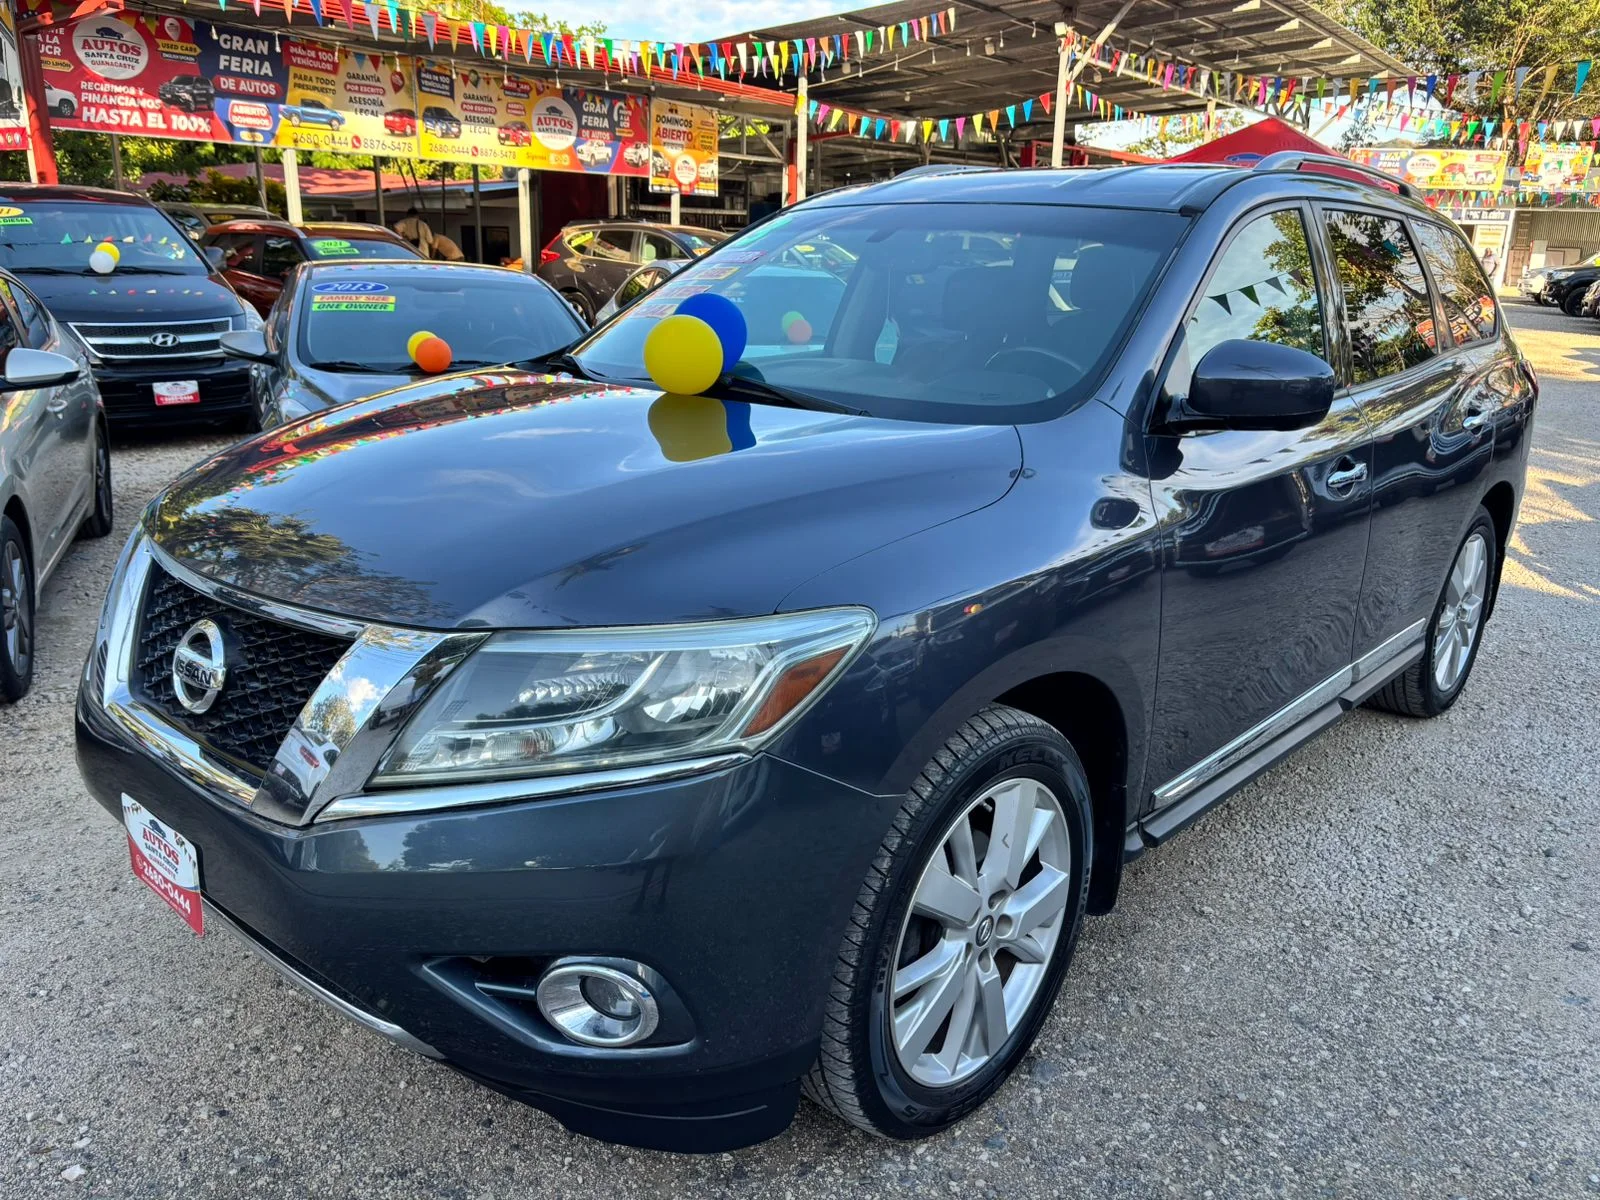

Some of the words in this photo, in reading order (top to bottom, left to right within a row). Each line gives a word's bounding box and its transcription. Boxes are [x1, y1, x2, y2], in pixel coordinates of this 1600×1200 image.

[46, 35, 60, 44] LA
[218, 34, 270, 56] GRAN
[81, 39, 142, 57] AUTOS
[161, 42, 179, 51] USED
[180, 44, 198, 54] CARS
[84, 52, 114, 60] SANTA
[116, 54, 140, 64] CRUZ
[318, 52, 332, 62] 100
[90, 60, 136, 71] GUANACASTE
[218, 54, 274, 77] FERIA
[293, 72, 314, 84] PARA
[316, 76, 336, 86] TODO
[346, 72, 382, 83] GARANTÍA
[80, 80, 136, 95] RECIBIMOS
[137, 87, 144, 96] Y
[220, 78, 236, 90] DE
[239, 82, 277, 96] AUTOS
[293, 82, 337, 96] PRESUPUESTO
[346, 84, 358, 92] POR
[359, 86, 384, 94] ESCRITO
[81, 92, 162, 110] FINANCIAMOS
[348, 95, 385, 108] ASESORÍA
[463, 92, 493, 103] GARANTÍA
[354, 108, 380, 118] LEGAL
[582, 102, 608, 114] GRAN
[82, 106, 144, 127] HASTA
[146, 112, 168, 129] EL
[170, 114, 212, 134] 100%
[464, 114, 496, 125] ASESORÍA
[536, 116, 574, 130] AUTOS
[582, 114, 610, 128] FERIA
[656, 114, 693, 128] DOMINGOS
[469, 126, 491, 135] LEGAL
[582, 129, 590, 139] DE
[590, 130, 611, 140] AUTOS
[655, 127, 694, 142] ABIERTO
[292, 132, 349, 145] 2680-0444
[363, 138, 413, 152] 8876-5478
[324, 282, 376, 291] 2013
[142, 827, 180, 866] AUTOS
[142, 864, 191, 914] 2680-0444
